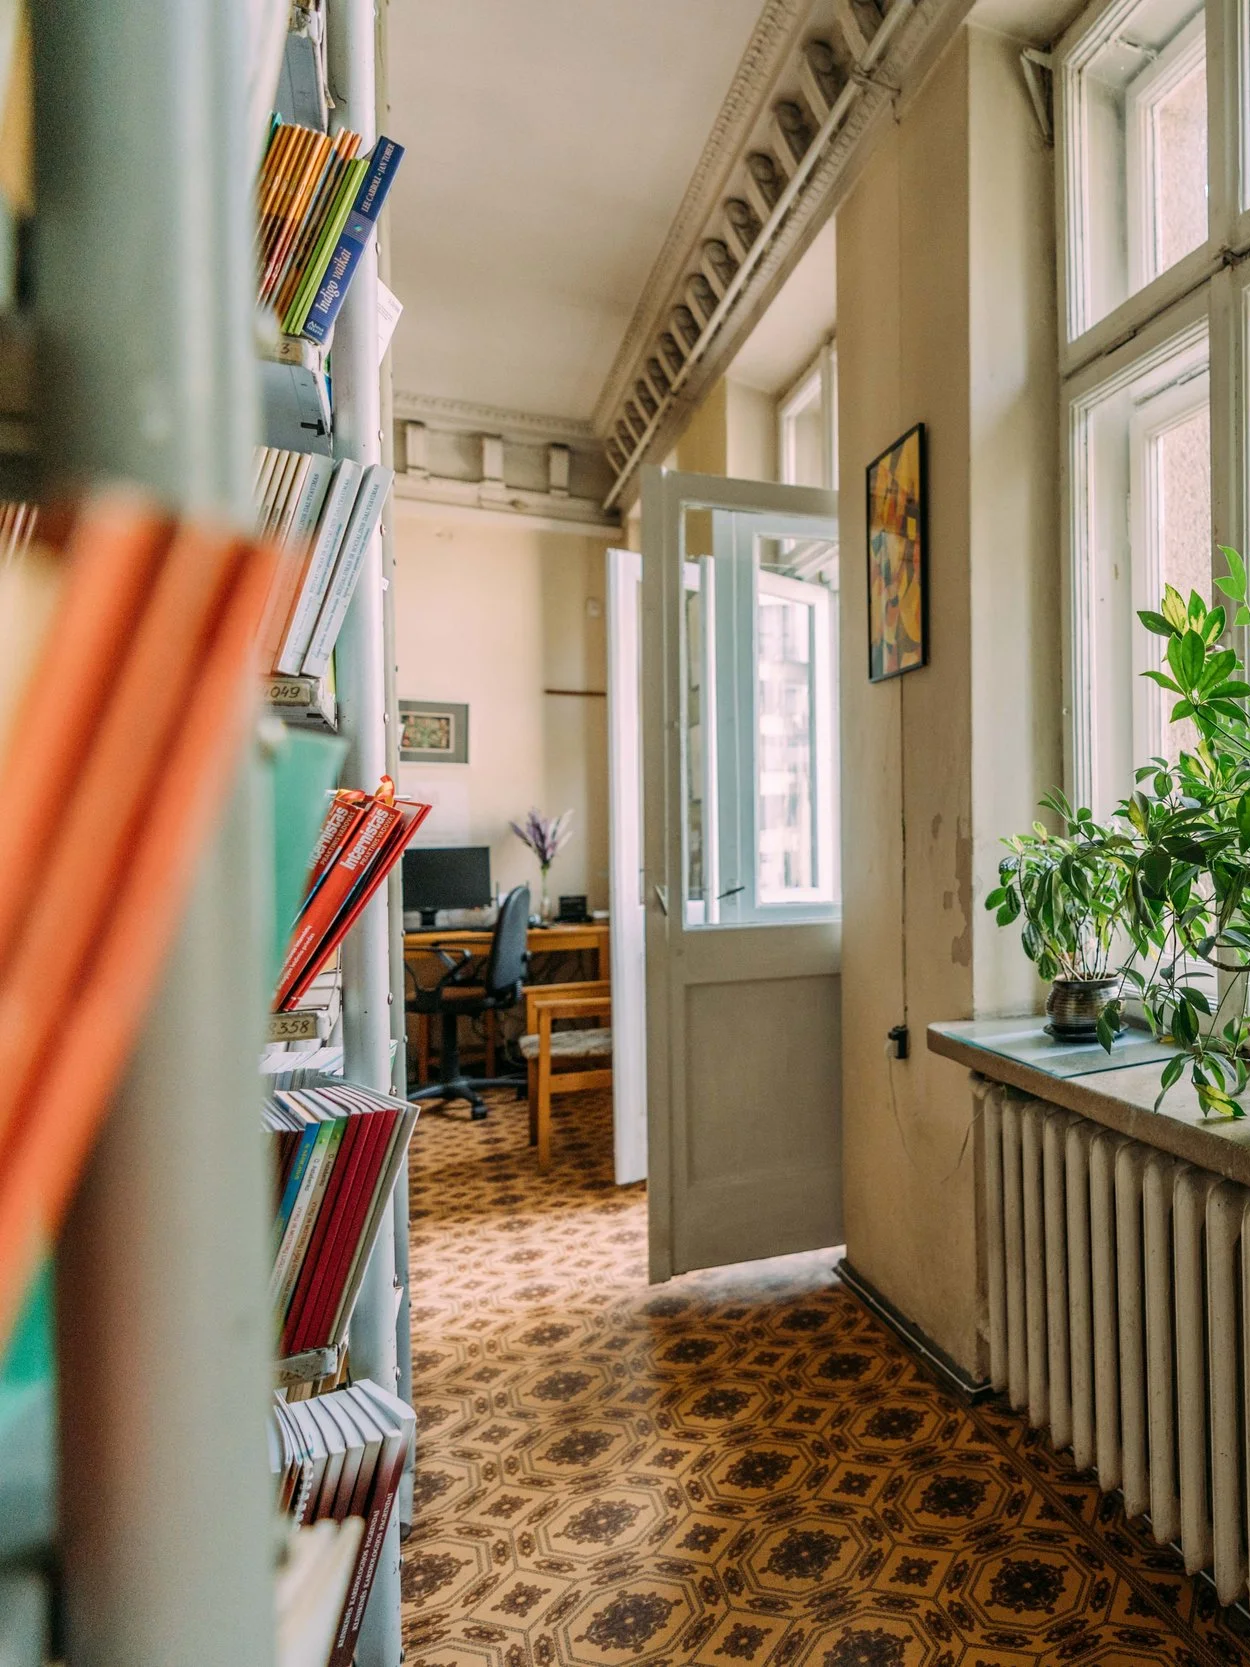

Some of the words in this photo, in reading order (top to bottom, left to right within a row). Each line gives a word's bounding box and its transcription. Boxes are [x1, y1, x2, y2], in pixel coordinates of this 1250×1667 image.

[360, 199, 371, 212] LEE
[366, 174, 381, 201] CARROLL
[377, 159, 387, 174] JAN
[383, 143, 394, 162] TOBER
[315, 284, 339, 313] Indigo
[332, 247, 351, 280] vaikai
[321, 836, 340, 865] PRAKTINIS
[338, 811, 355, 838] VADOVAS
[340, 806, 389, 870] Internistas
[361, 834, 382, 865] PRAKTINIS
[380, 813, 395, 836] VADOVAS
[365, 1510, 380, 1547] PAGRINDAI
[379, 1494, 393, 1530] PAGRINDAI
